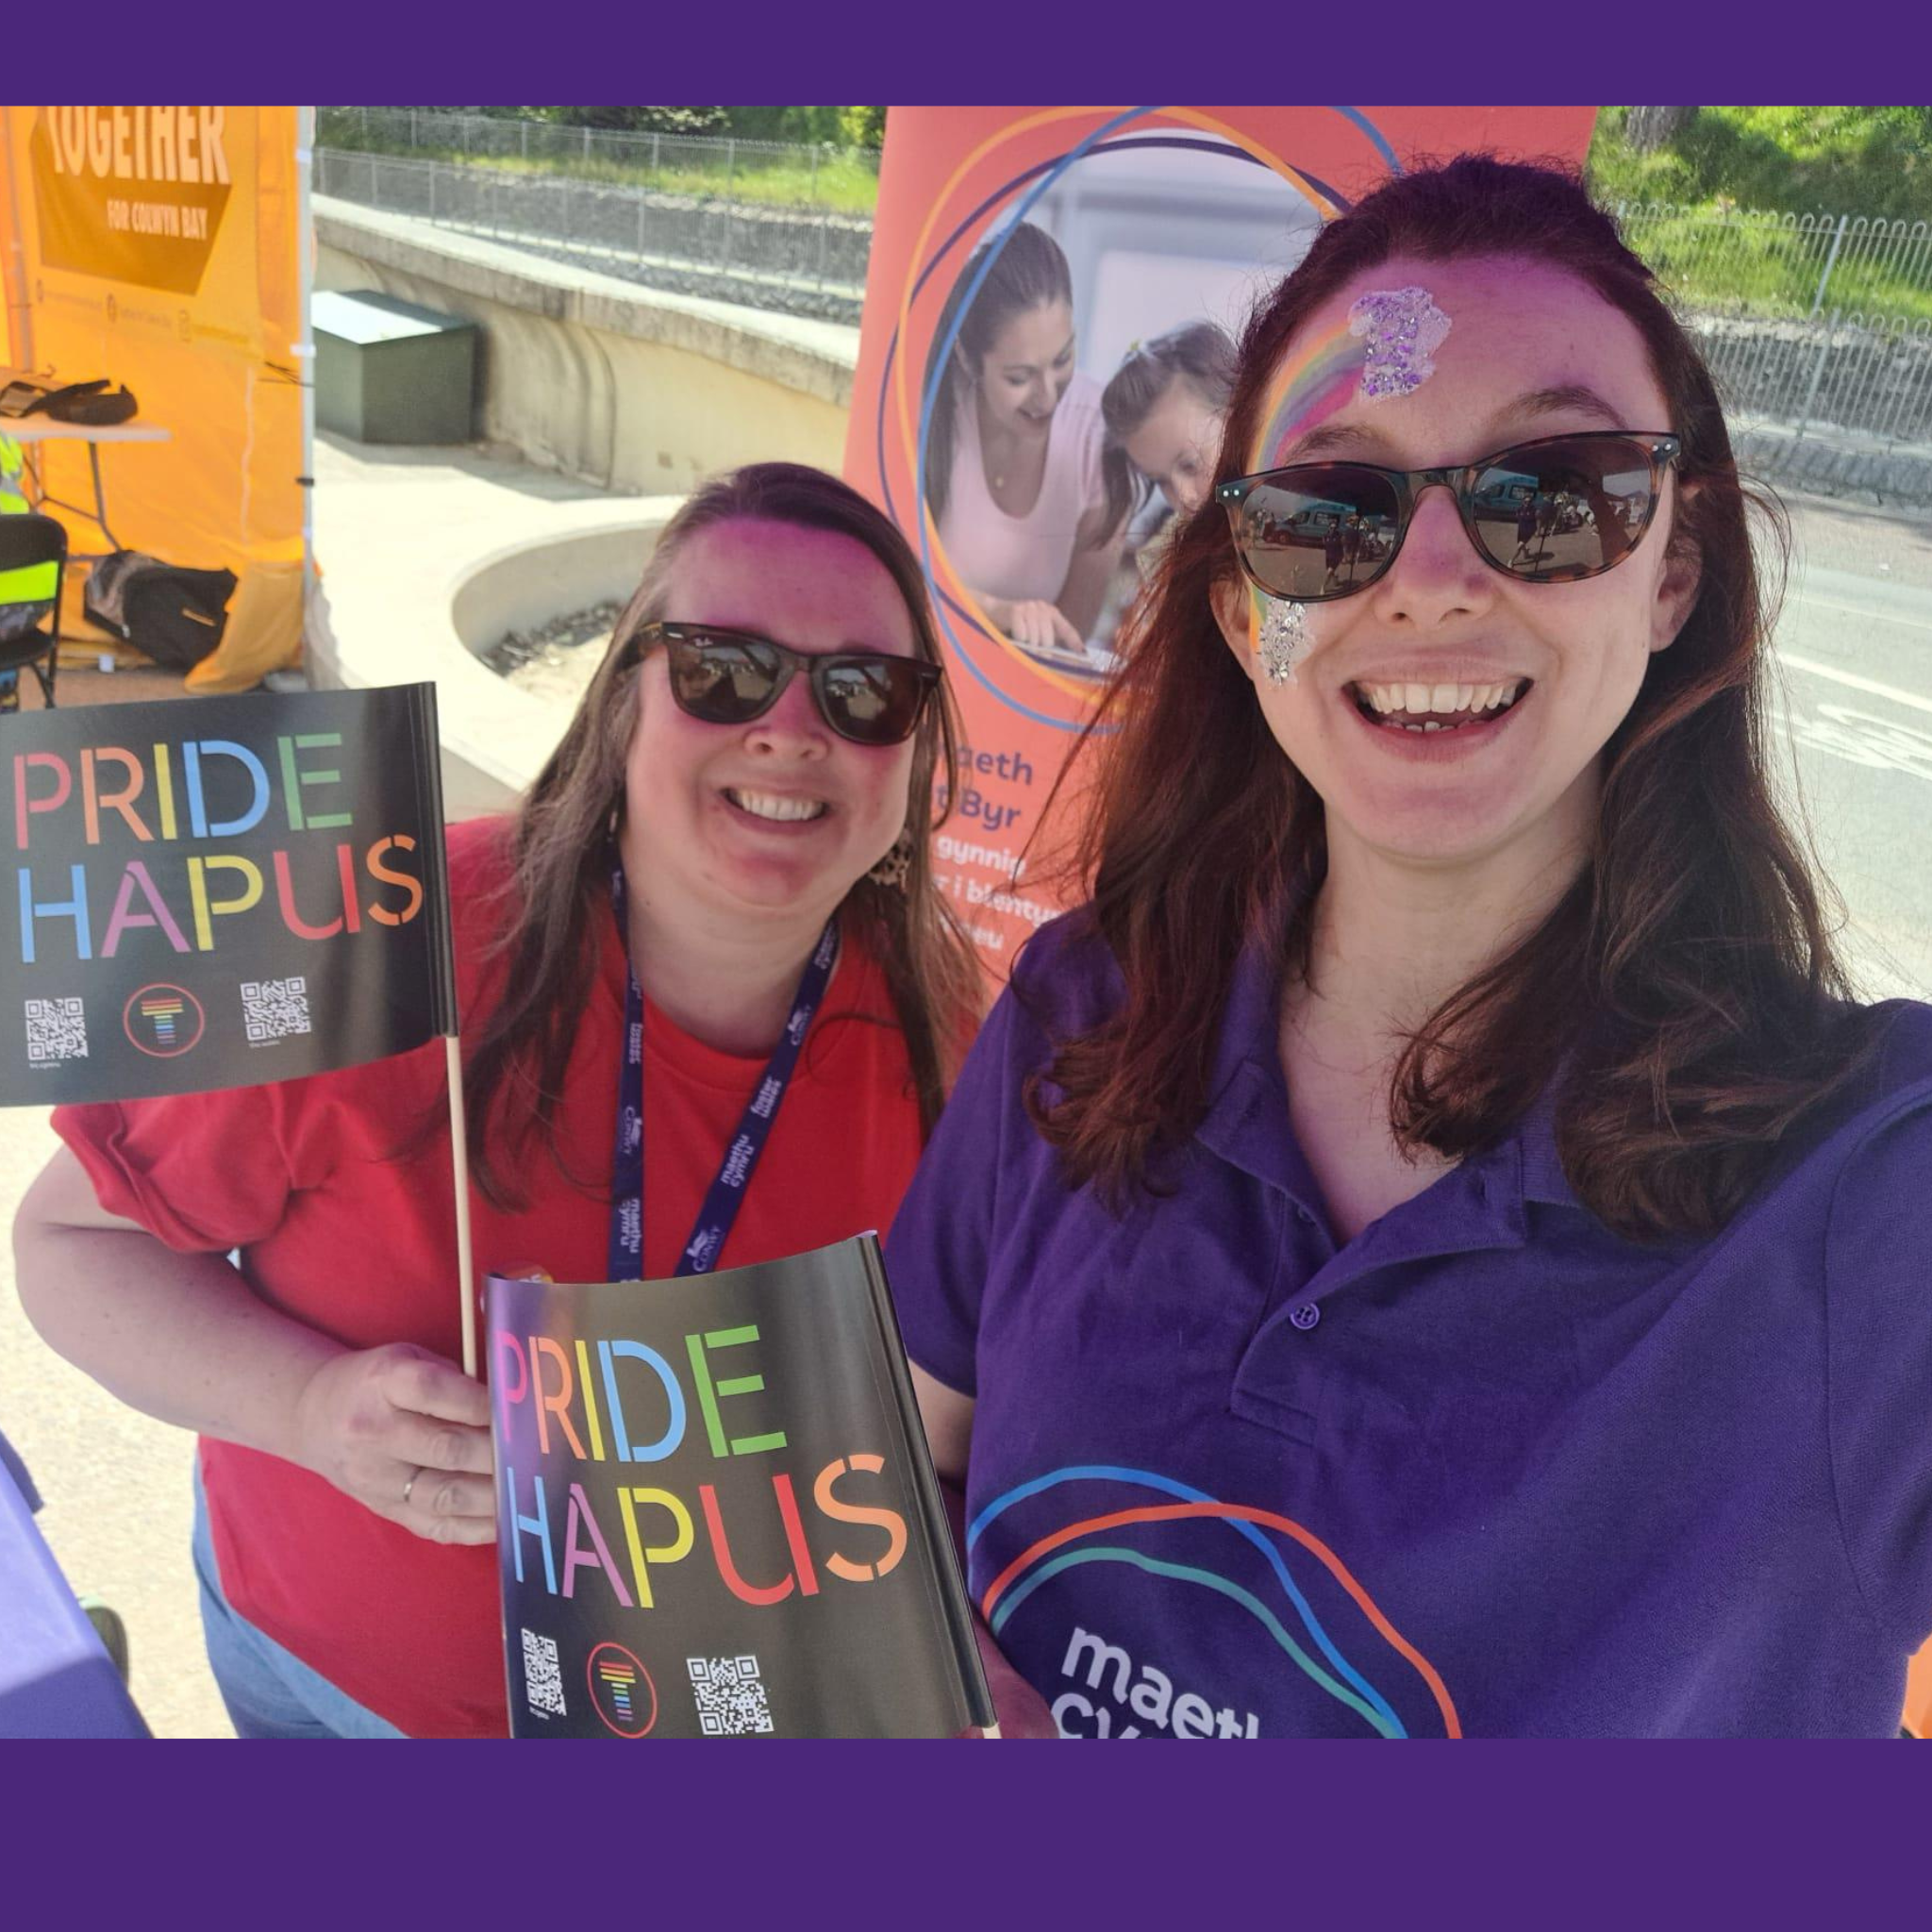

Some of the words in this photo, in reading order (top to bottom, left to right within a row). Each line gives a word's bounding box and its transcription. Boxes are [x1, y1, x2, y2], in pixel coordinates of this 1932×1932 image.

[13, 732, 353, 850] PRIDE
[955, 744, 1033, 786] aeth
[959, 787, 1022, 831] Byr
[17, 834, 424, 964] HAPUS
[720, 1133, 750, 1185] maethu
[729, 1144, 755, 1188] cymru
[629, 1197, 642, 1254] maethu
[494, 1324, 787, 1463] PRIDE
[506, 1453, 908, 1609] HAPUS
